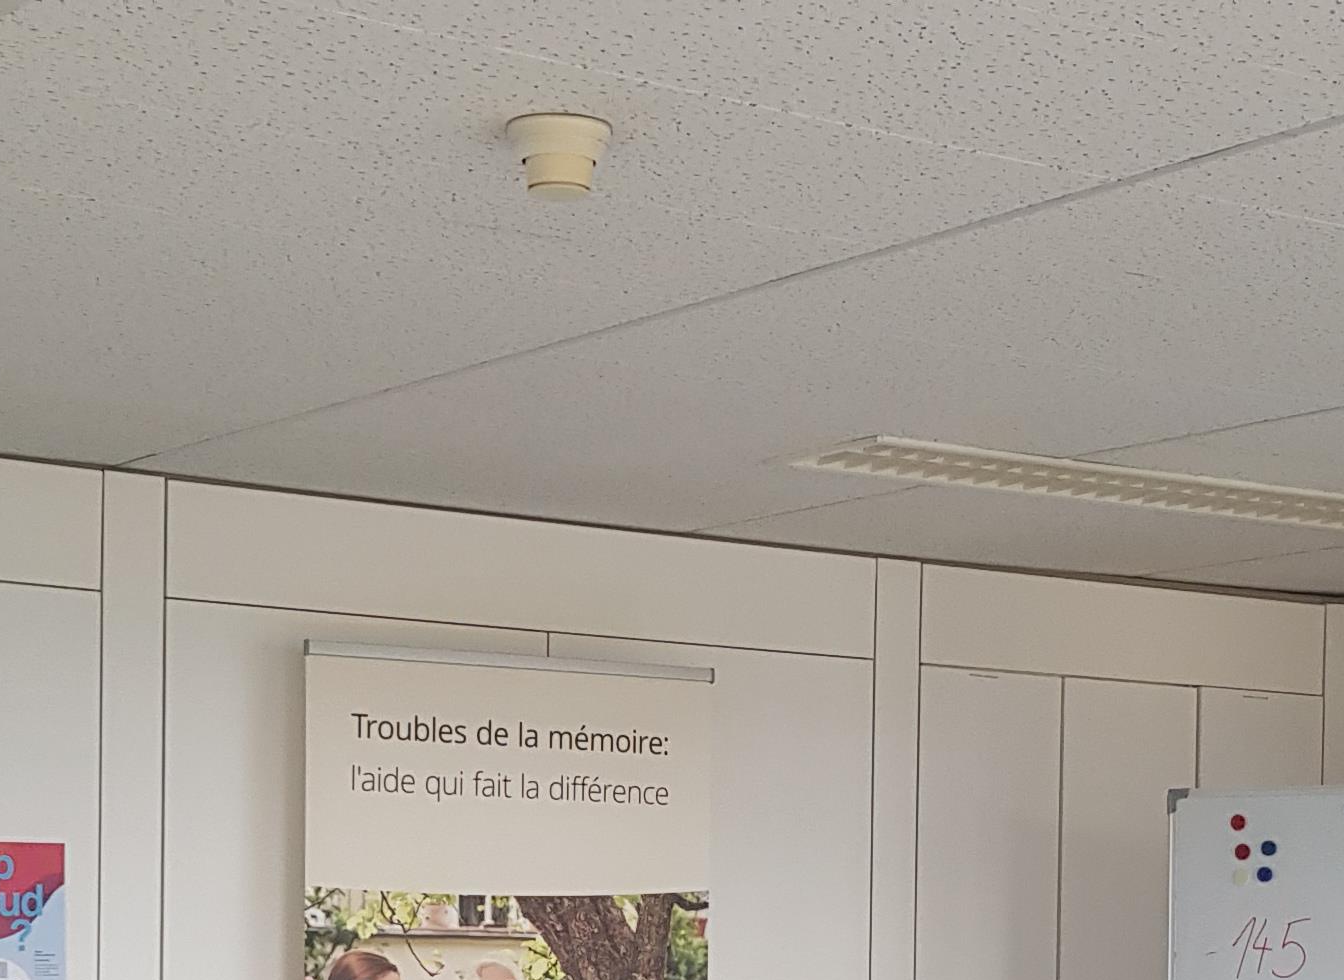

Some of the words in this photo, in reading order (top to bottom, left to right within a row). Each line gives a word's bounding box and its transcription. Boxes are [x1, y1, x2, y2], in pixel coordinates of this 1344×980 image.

[351, 712, 467, 746] Troubles
[476, 718, 509, 746] de
[518, 721, 539, 748] la
[548, 724, 670, 756] mémoire:
[350, 764, 415, 795] l'aide
[424, 770, 465, 802] qui
[472, 770, 513, 799] fait
[520, 773, 540, 799] la
[548, 775, 670, 806] différence
[10, 918, 32, 951] ?
[1232, 916, 1312, 980] 145
